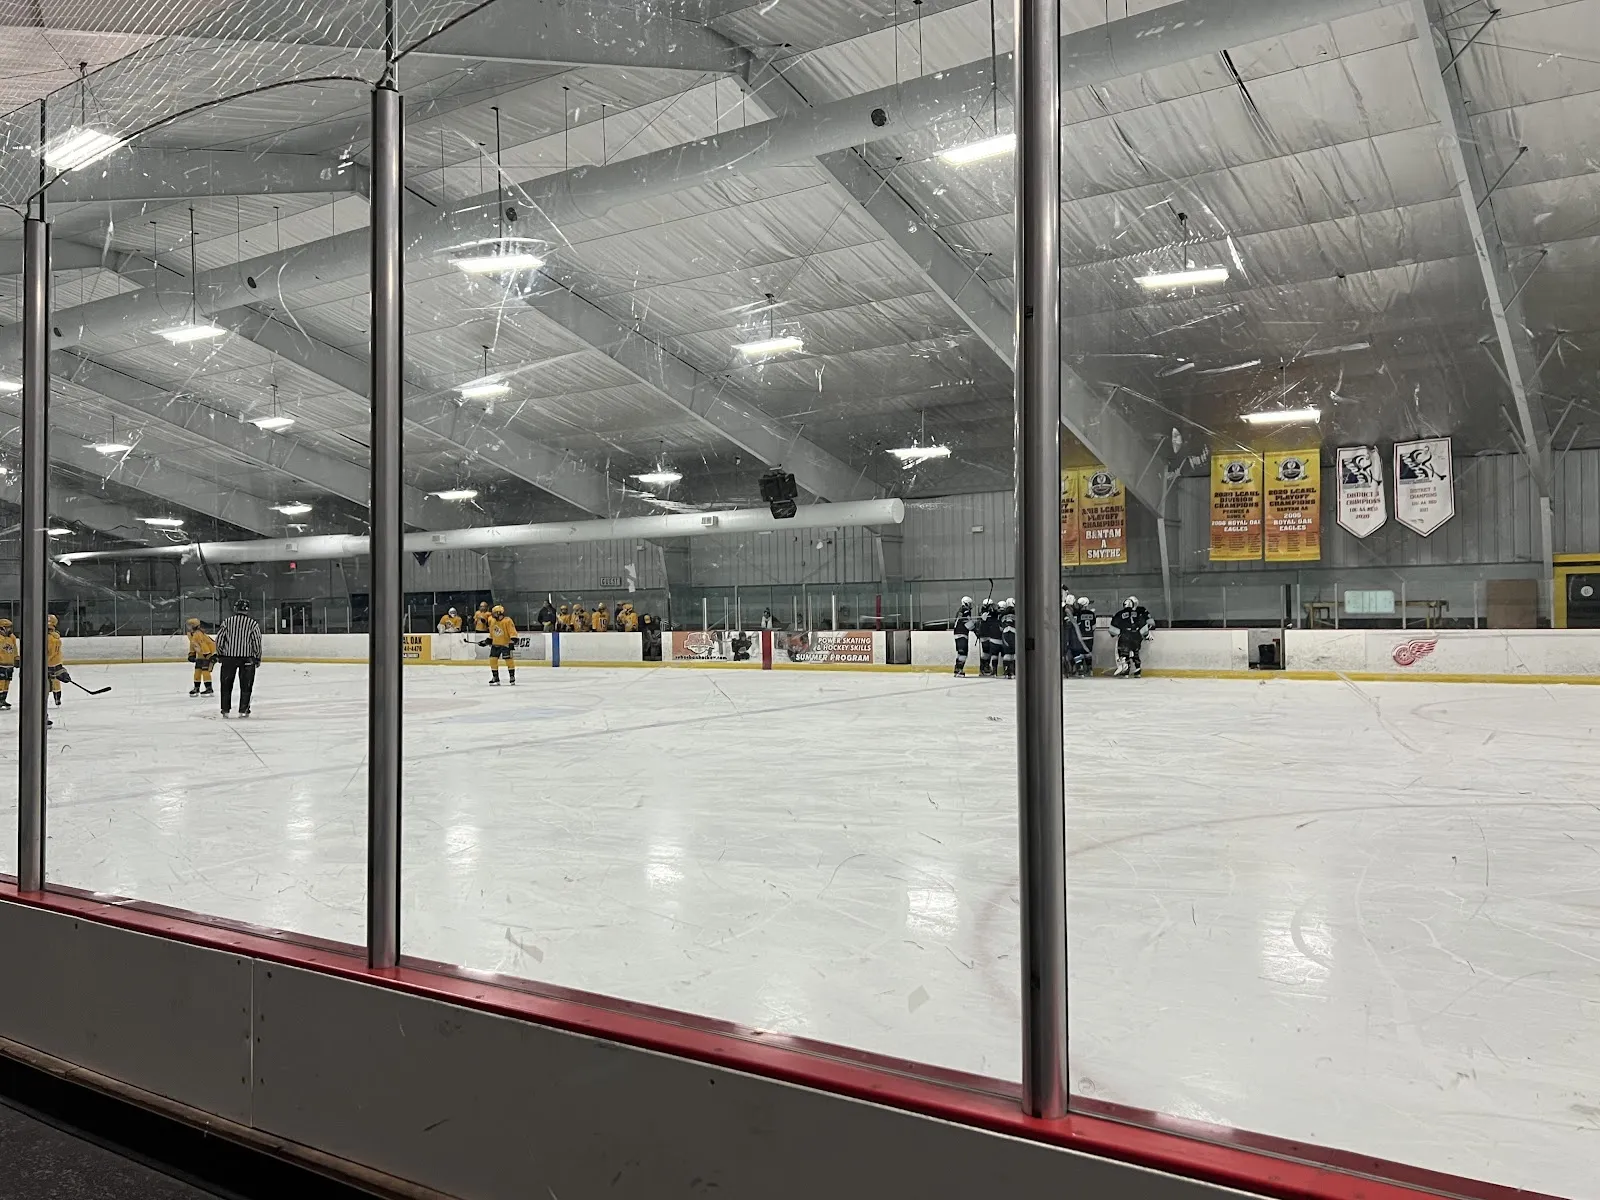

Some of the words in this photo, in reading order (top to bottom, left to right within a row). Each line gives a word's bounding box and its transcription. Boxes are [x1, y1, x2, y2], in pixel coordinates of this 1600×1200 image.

[1088, 513, 1118, 522] PLAYOFF
[1082, 520, 1124, 528] CHAMPIONS
[1086, 528, 1122, 540] BANTAM
[1101, 540, 1106, 548] A
[1087, 548, 1120, 558] SMYTHE
[1084, 620, 1091, 632] 9
[410, 636, 422, 644] OAK
